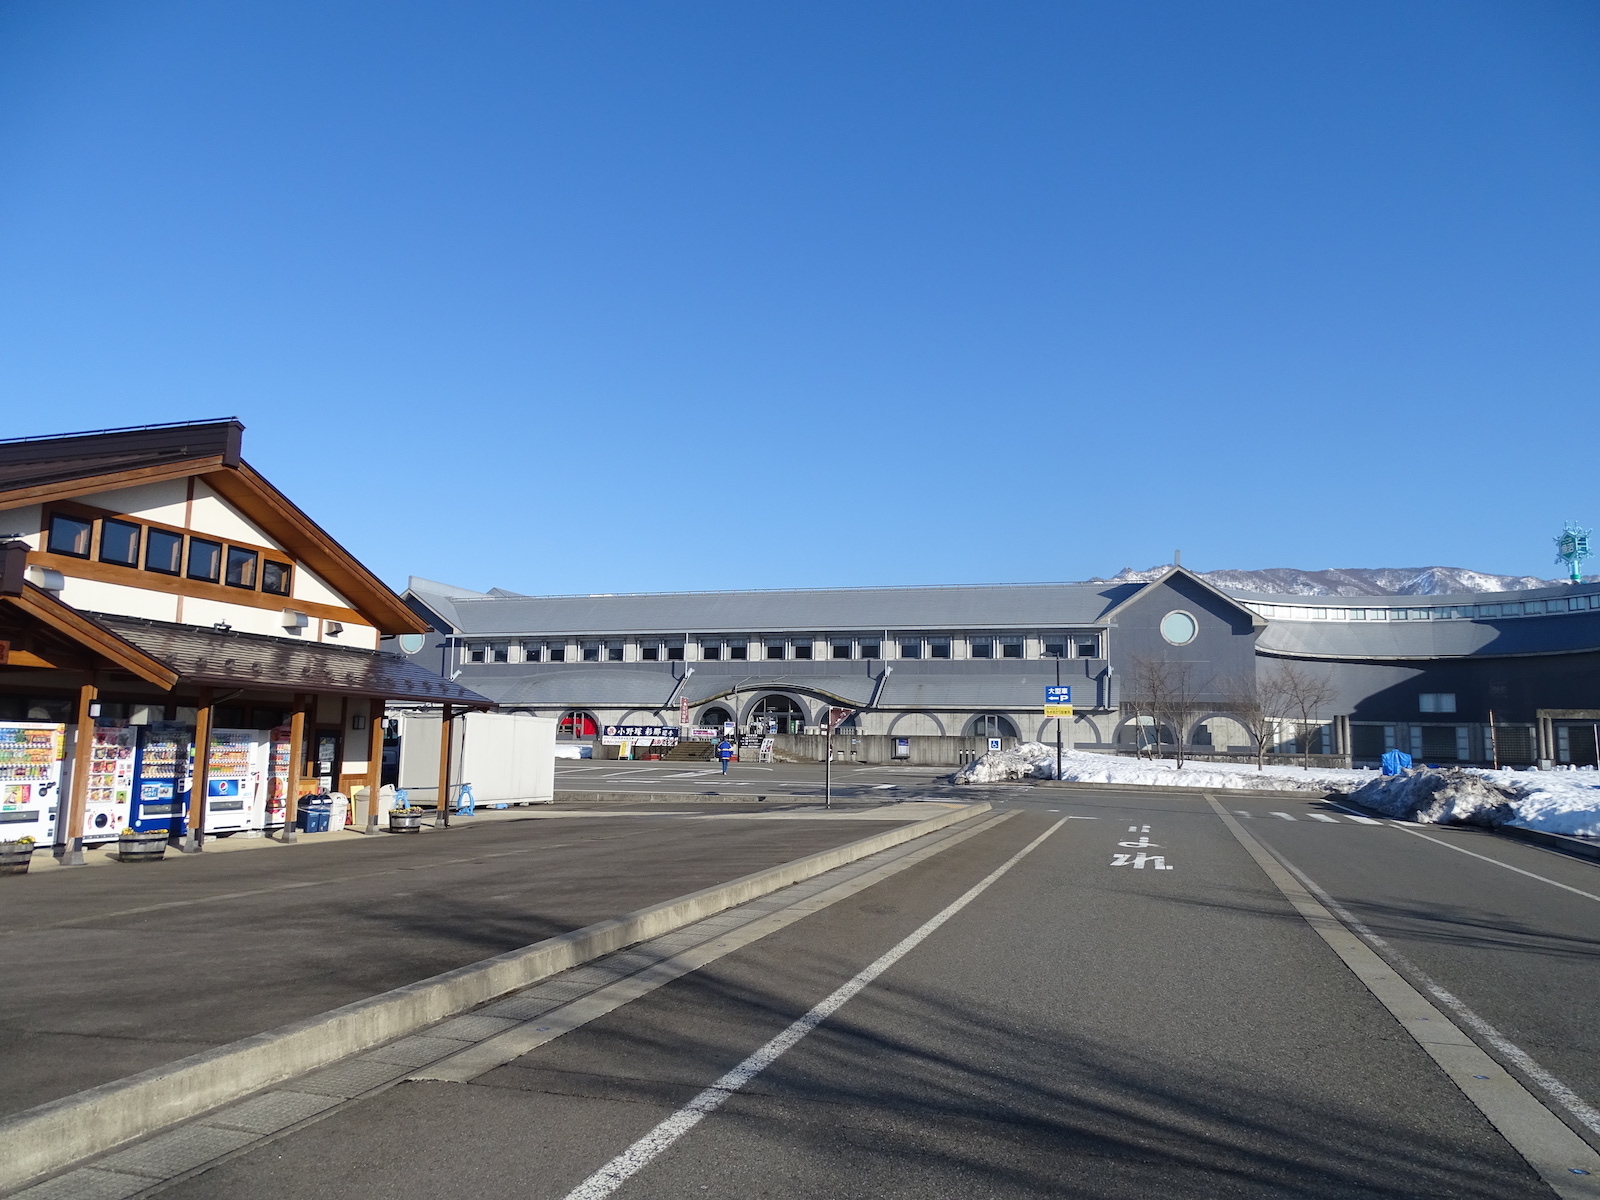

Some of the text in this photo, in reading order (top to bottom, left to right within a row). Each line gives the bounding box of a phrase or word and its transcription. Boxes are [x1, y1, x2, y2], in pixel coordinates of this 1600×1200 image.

[1048, 687, 1068, 695] 大型車
[1060, 694, 1069, 702] P
